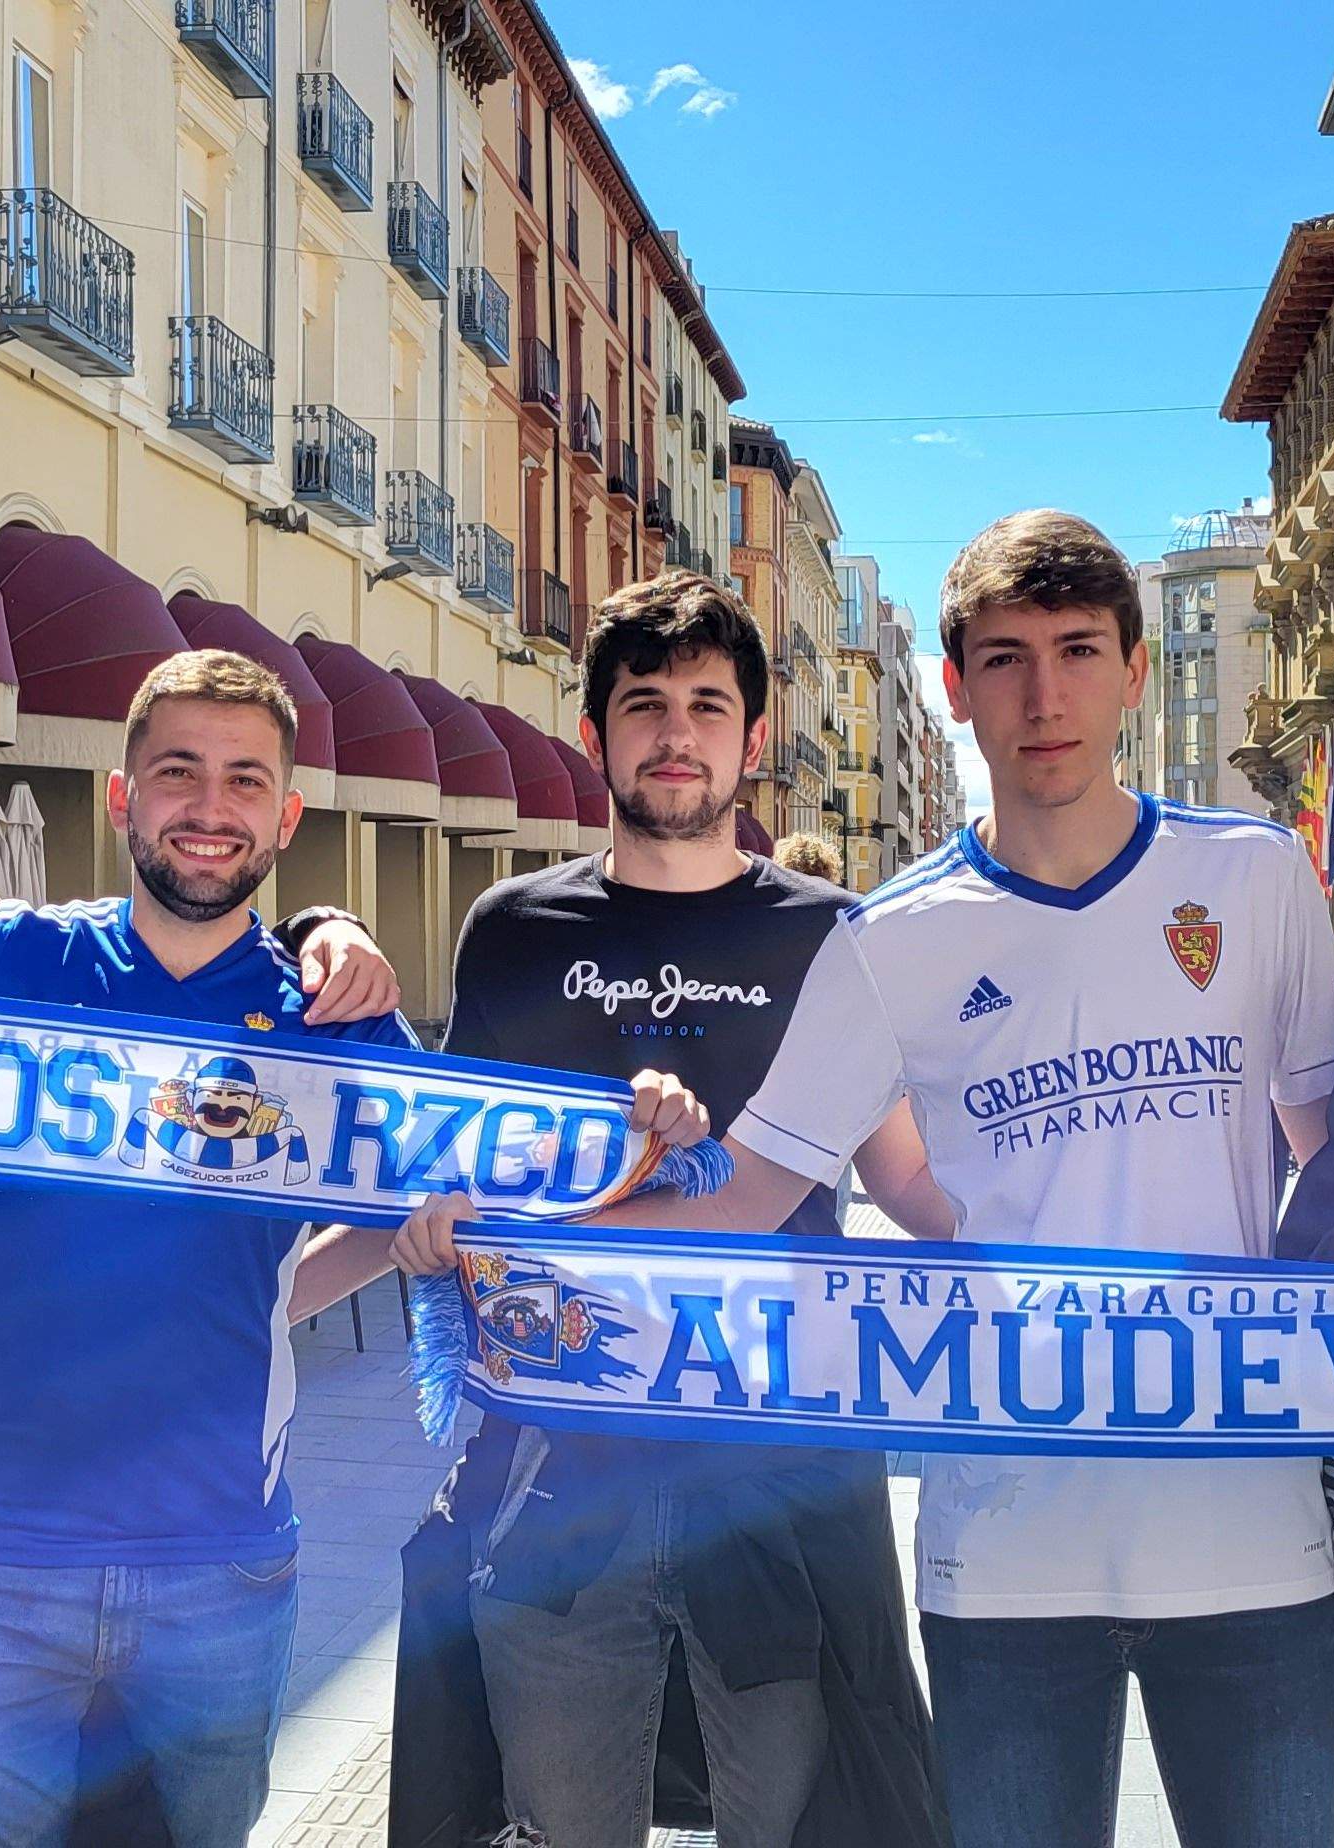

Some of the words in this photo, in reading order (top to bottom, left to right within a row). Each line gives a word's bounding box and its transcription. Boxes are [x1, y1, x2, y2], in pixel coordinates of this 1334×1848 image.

[563, 960, 653, 1016] Pepe
[651, 964, 772, 1018] Jeans
[959, 994, 1012, 1023] adidas
[620, 1023, 705, 1037] LONDON
[963, 1052, 1079, 1120] GREEN
[1081, 1035, 1243, 1087] BOTANIC
[319, 1078, 632, 1203] RZCD
[994, 1088, 1231, 1159] PHARMACIE
[160, 1159, 234, 1184] CABEZUDOS
[235, 1169, 269, 1184] RZCD
[825, 1269, 974, 1308] PEÑA
